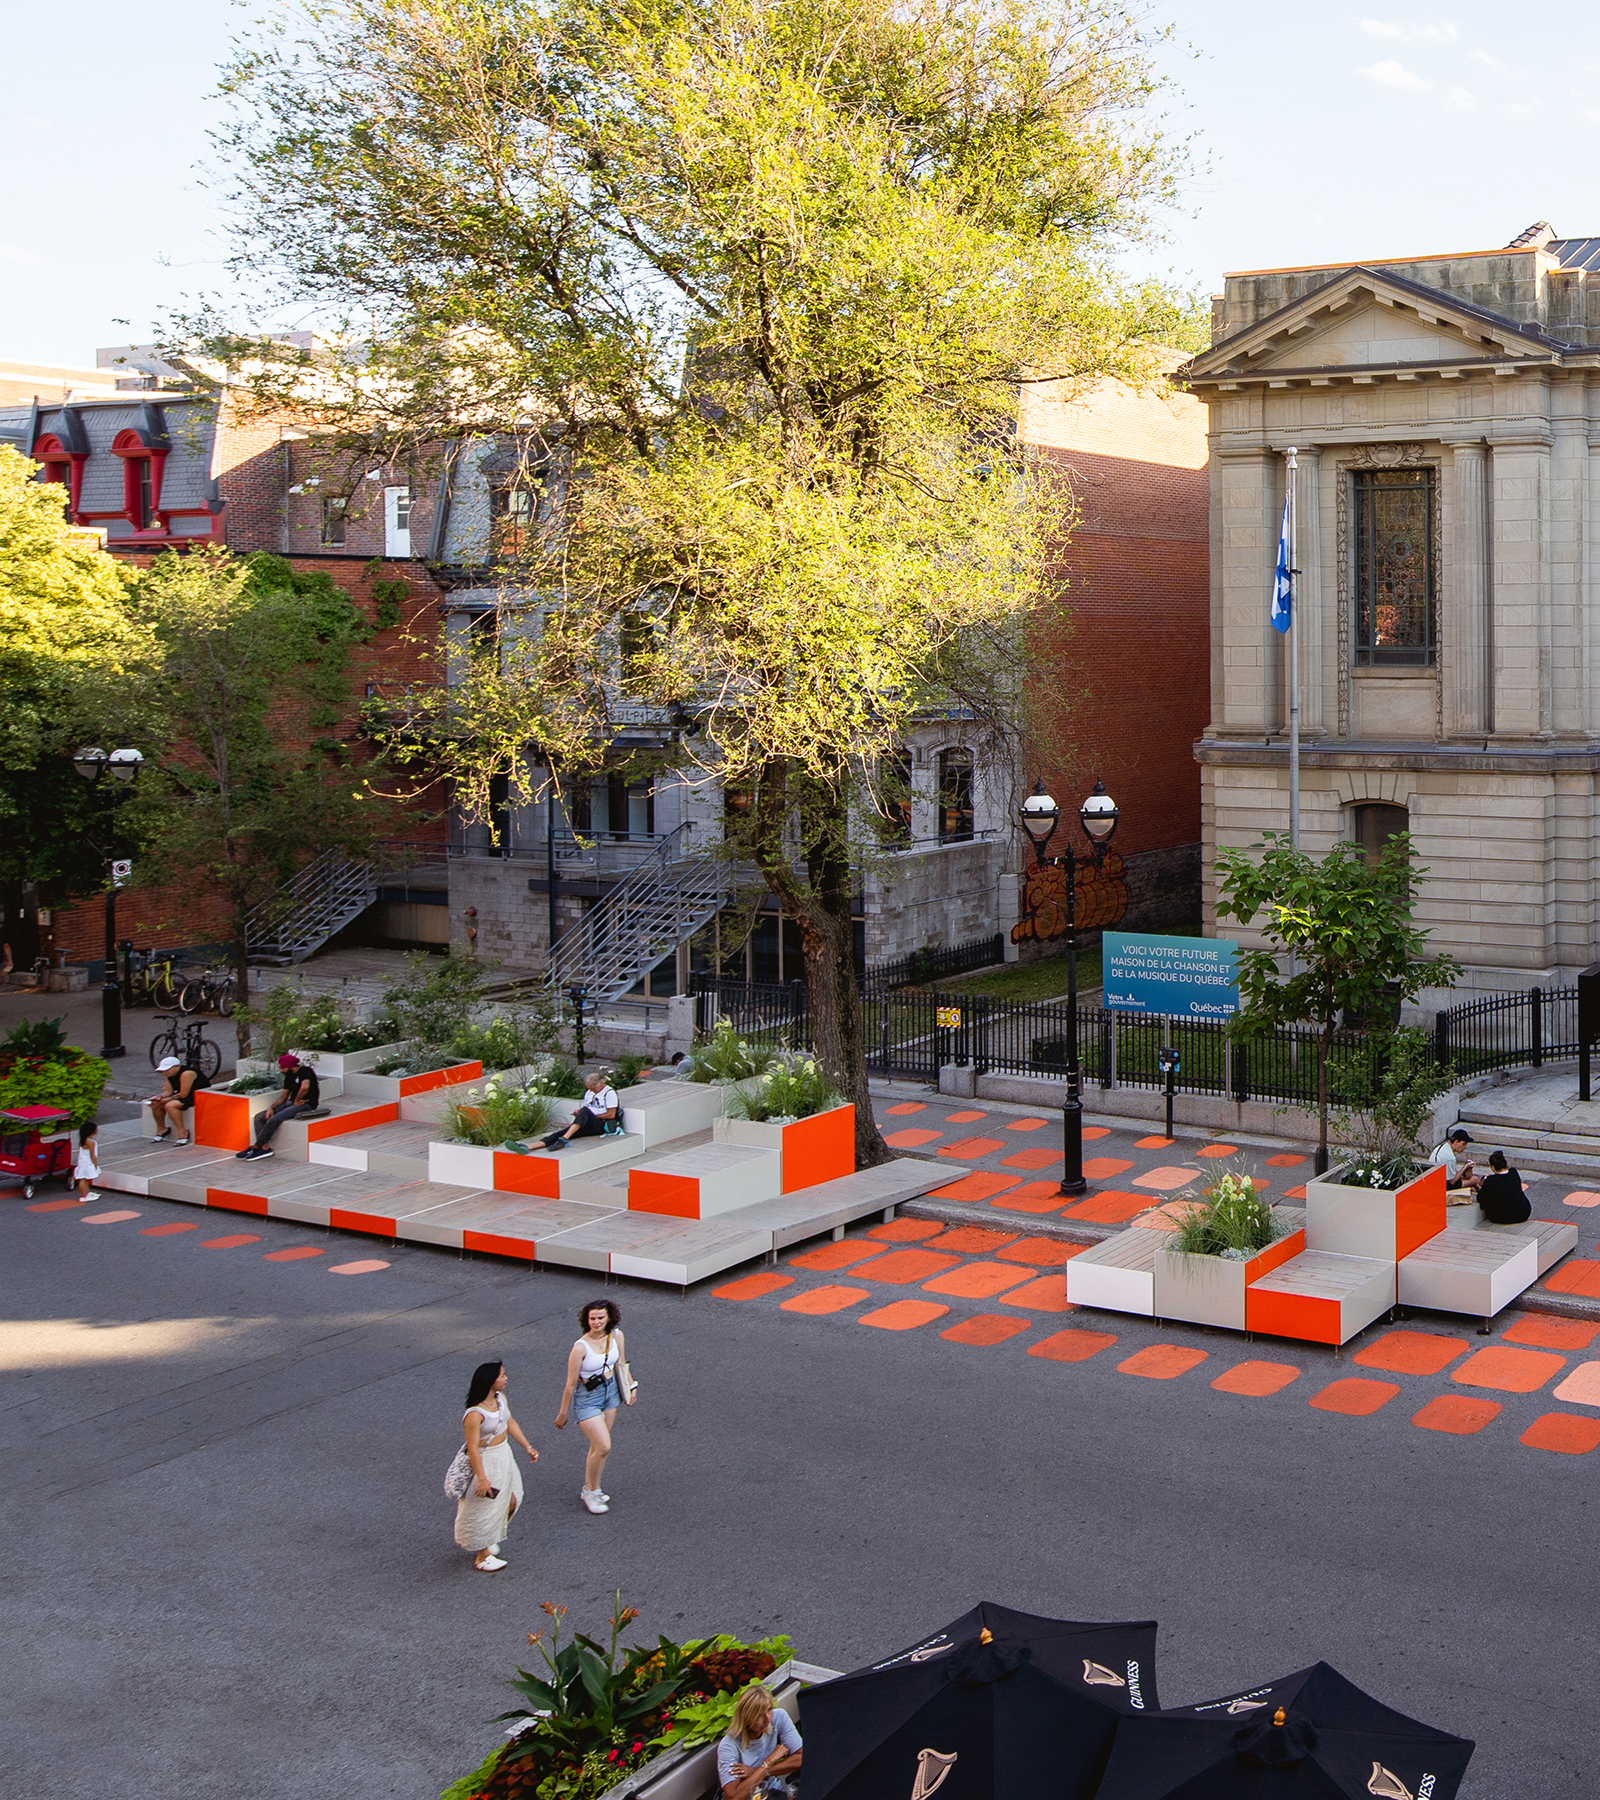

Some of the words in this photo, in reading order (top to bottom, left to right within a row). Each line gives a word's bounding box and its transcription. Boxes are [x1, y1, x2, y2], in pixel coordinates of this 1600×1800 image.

[1122, 945, 1147, 956] VOICI
[1149, 947, 1179, 958] VOTRE
[1182, 950, 1218, 961] FUTURE
[1111, 957, 1145, 968] MAISON
[1147, 959, 1158, 968] DE
[1161, 961, 1171, 969] LA
[1174, 961, 1218, 973] CHANSON
[1219, 965, 1230, 974] ET
[1112, 969, 1123, 978] DE
[1125, 970, 1136, 979] LA
[1138, 971, 1177, 983] MUSIQUE
[1180, 974, 1193, 983] DU
[1195, 974, 1230, 986] QUÉBEC
[1107, 993, 1123, 1001] Votre
[1108, 999, 1146, 1007] gouvernement
[1190, 1002, 1223, 1014] Québec
[1127, 1659, 1145, 1709] GUINNESS
